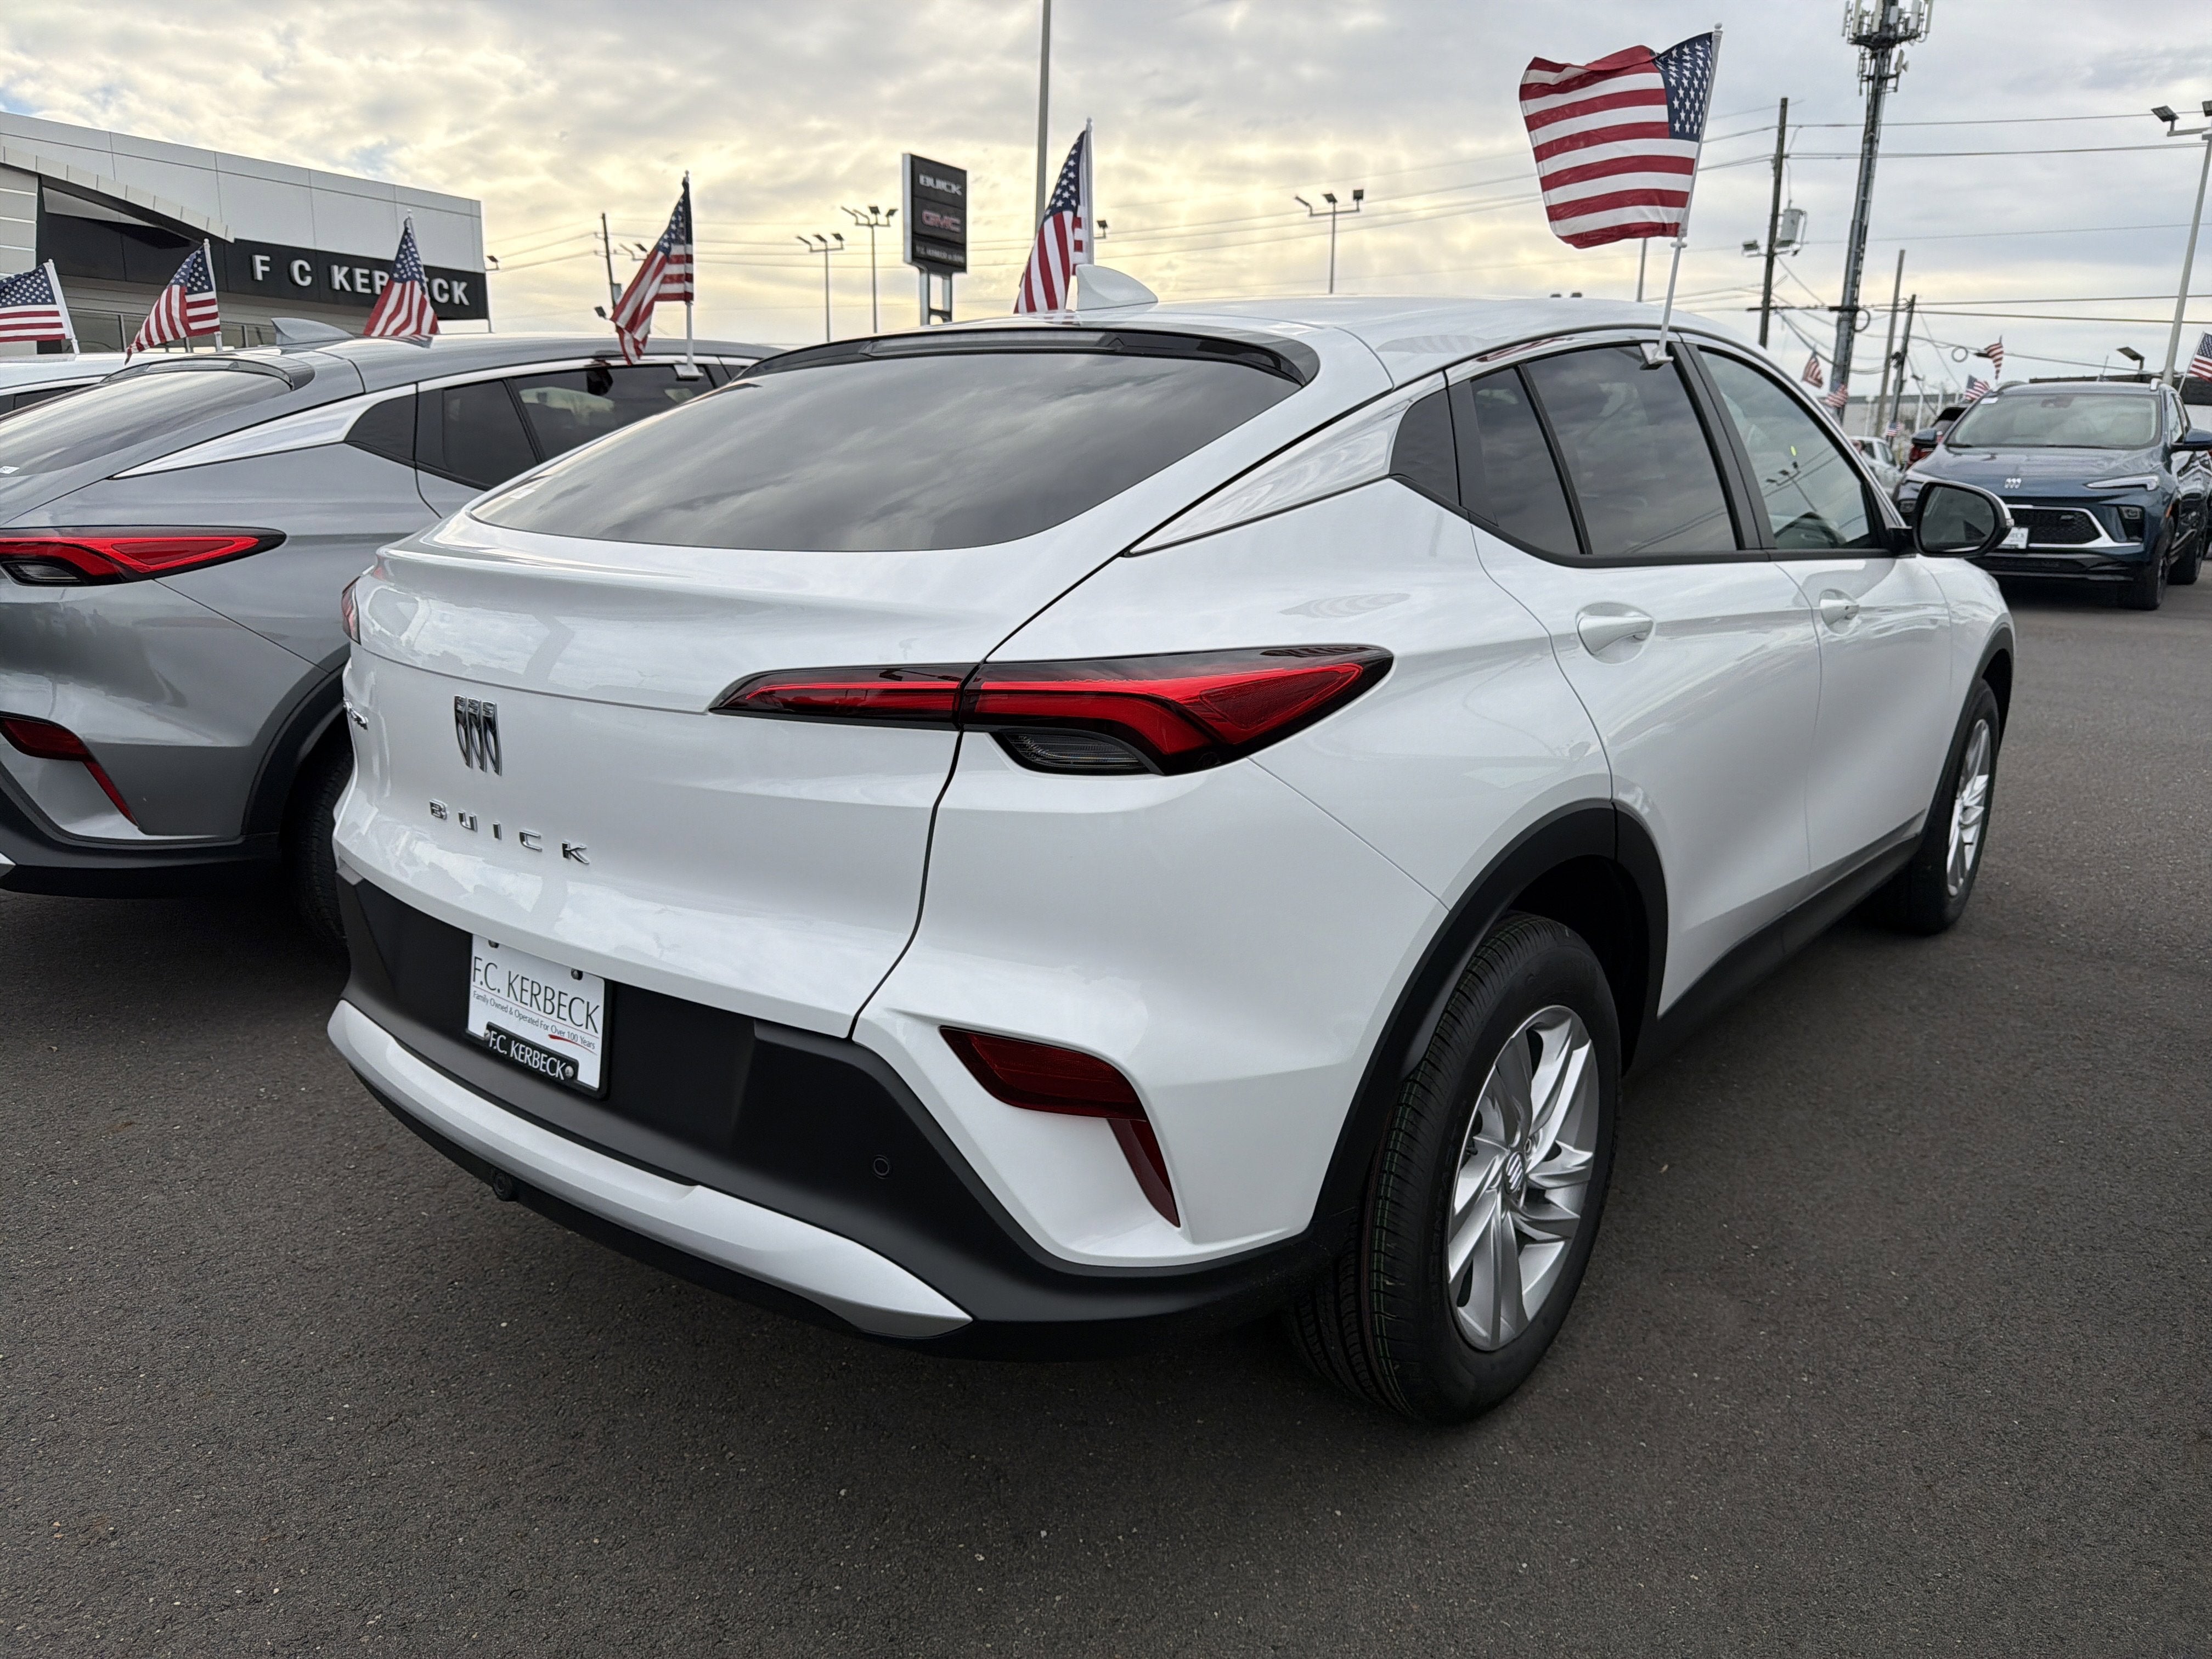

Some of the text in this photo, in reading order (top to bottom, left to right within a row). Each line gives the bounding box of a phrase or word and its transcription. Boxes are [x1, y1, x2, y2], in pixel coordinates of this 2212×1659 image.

[919, 173, 962, 195] BUICK
[251, 255, 470, 306] F C KERCK
[429, 798, 590, 865] BUICK
[472, 956, 600, 1034] F.C. KERBECK
[473, 990, 595, 1049] Family Owned & Operated For Over 100 Years
[489, 1030, 567, 1080] F.C. KERBECK
